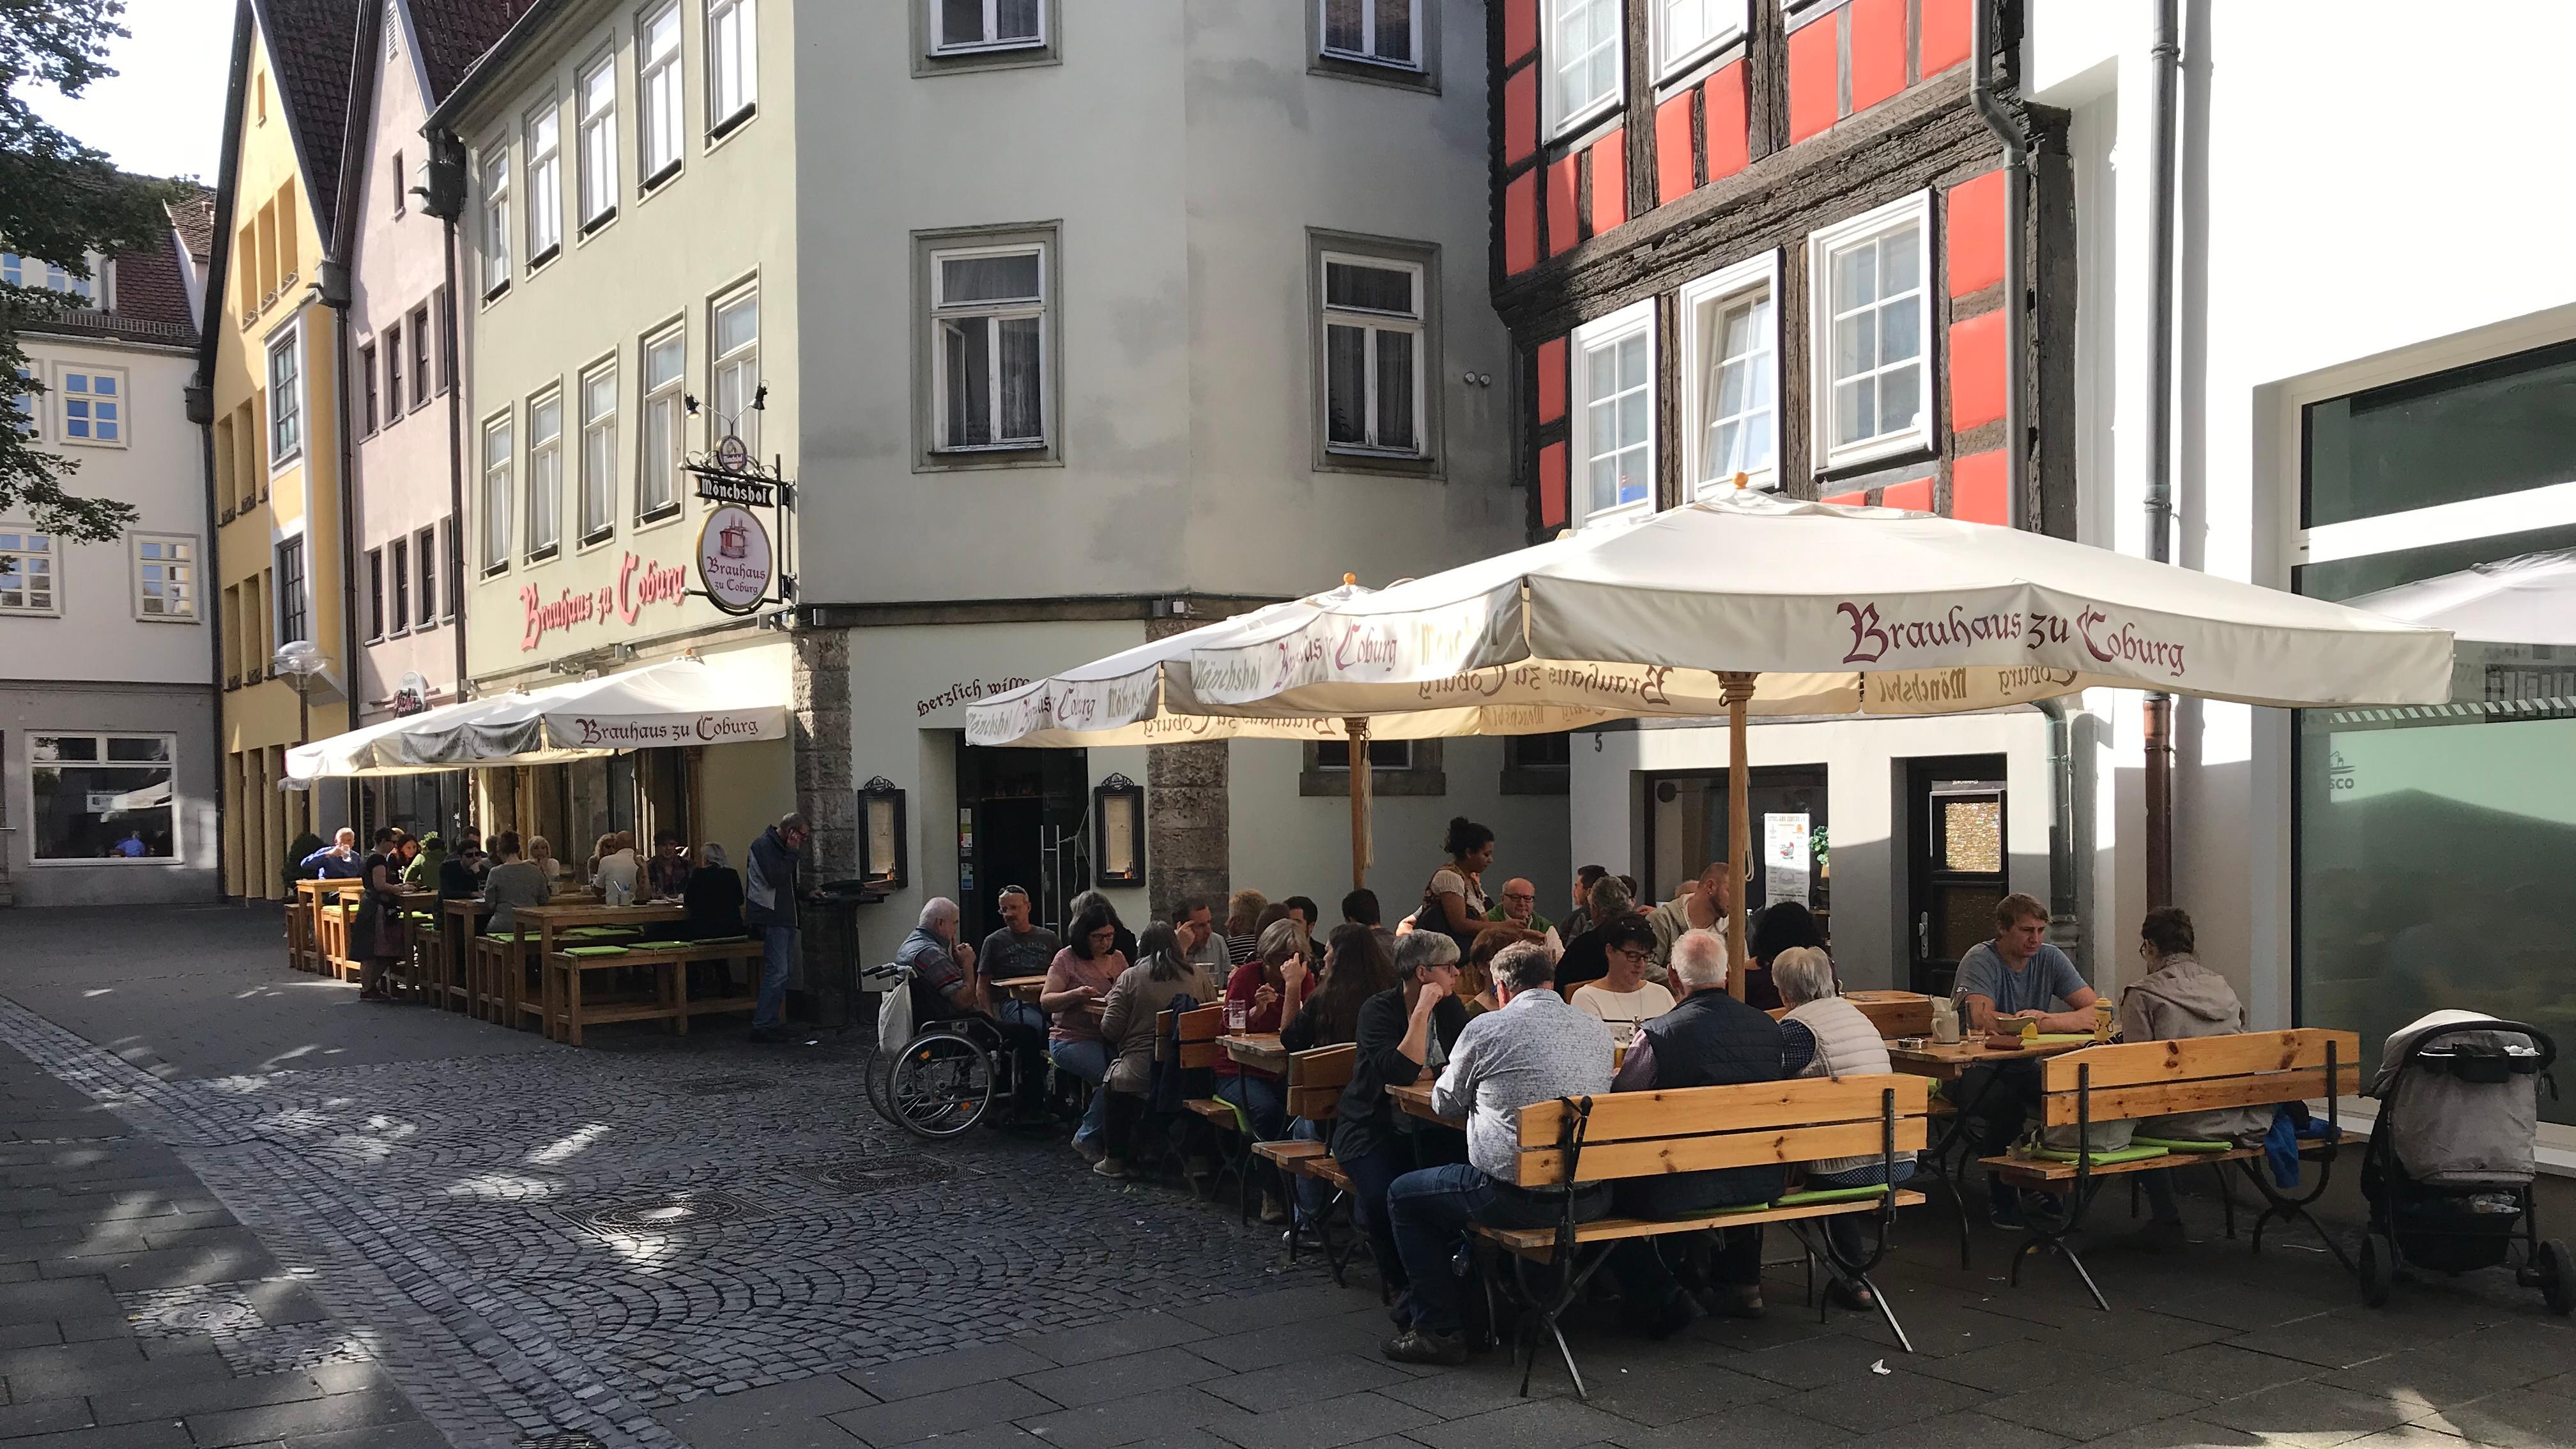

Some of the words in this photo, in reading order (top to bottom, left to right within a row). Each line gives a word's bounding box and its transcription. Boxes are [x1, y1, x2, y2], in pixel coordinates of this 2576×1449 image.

[702, 478, 767, 503] Mönchshof
[706, 556, 765, 579] Brauhaus
[715, 580, 724, 590] zu
[726, 579, 758, 595] Coburg
[519, 582, 593, 651] Brauhaus
[597, 586, 613, 625] zu
[618, 551, 686, 625] Coburg
[1335, 618, 1398, 672] Coburg
[1836, 601, 2023, 664] Brauhaus
[2027, 611, 2071, 650] zu
[2076, 603, 2186, 677] Coburg
[576, 719, 667, 744] Brauhaus
[672, 724, 691, 741] zu
[696, 716, 758, 741] Coburg
[1595, 732, 1603, 753] 5
